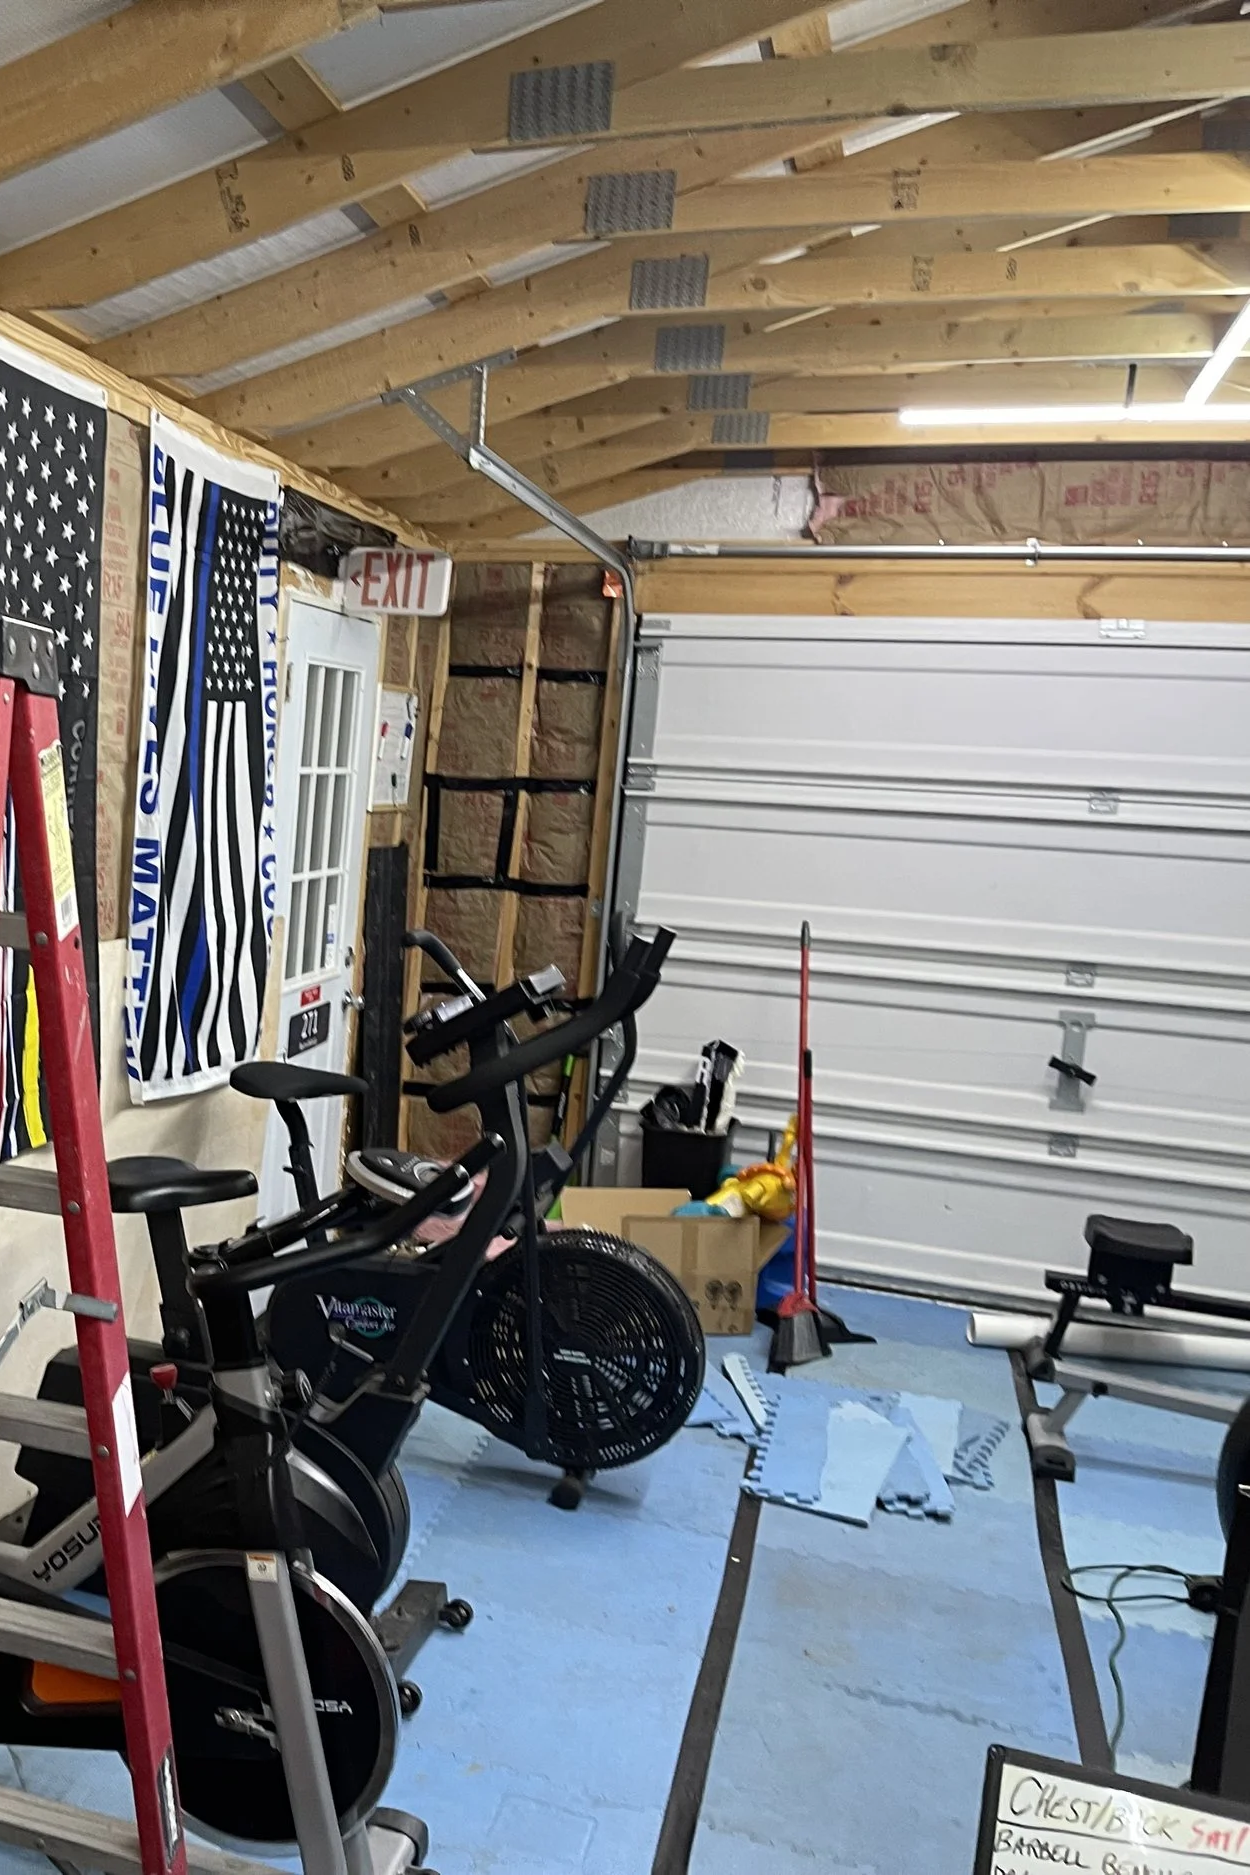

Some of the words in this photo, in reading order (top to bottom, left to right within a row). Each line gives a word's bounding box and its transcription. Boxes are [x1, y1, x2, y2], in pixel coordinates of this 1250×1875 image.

[150, 443, 171, 616] BLUE
[361, 551, 435, 610] EXIT
[313, 1292, 398, 1321] Vitamaster
[32, 1515, 101, 1583] YOSU
